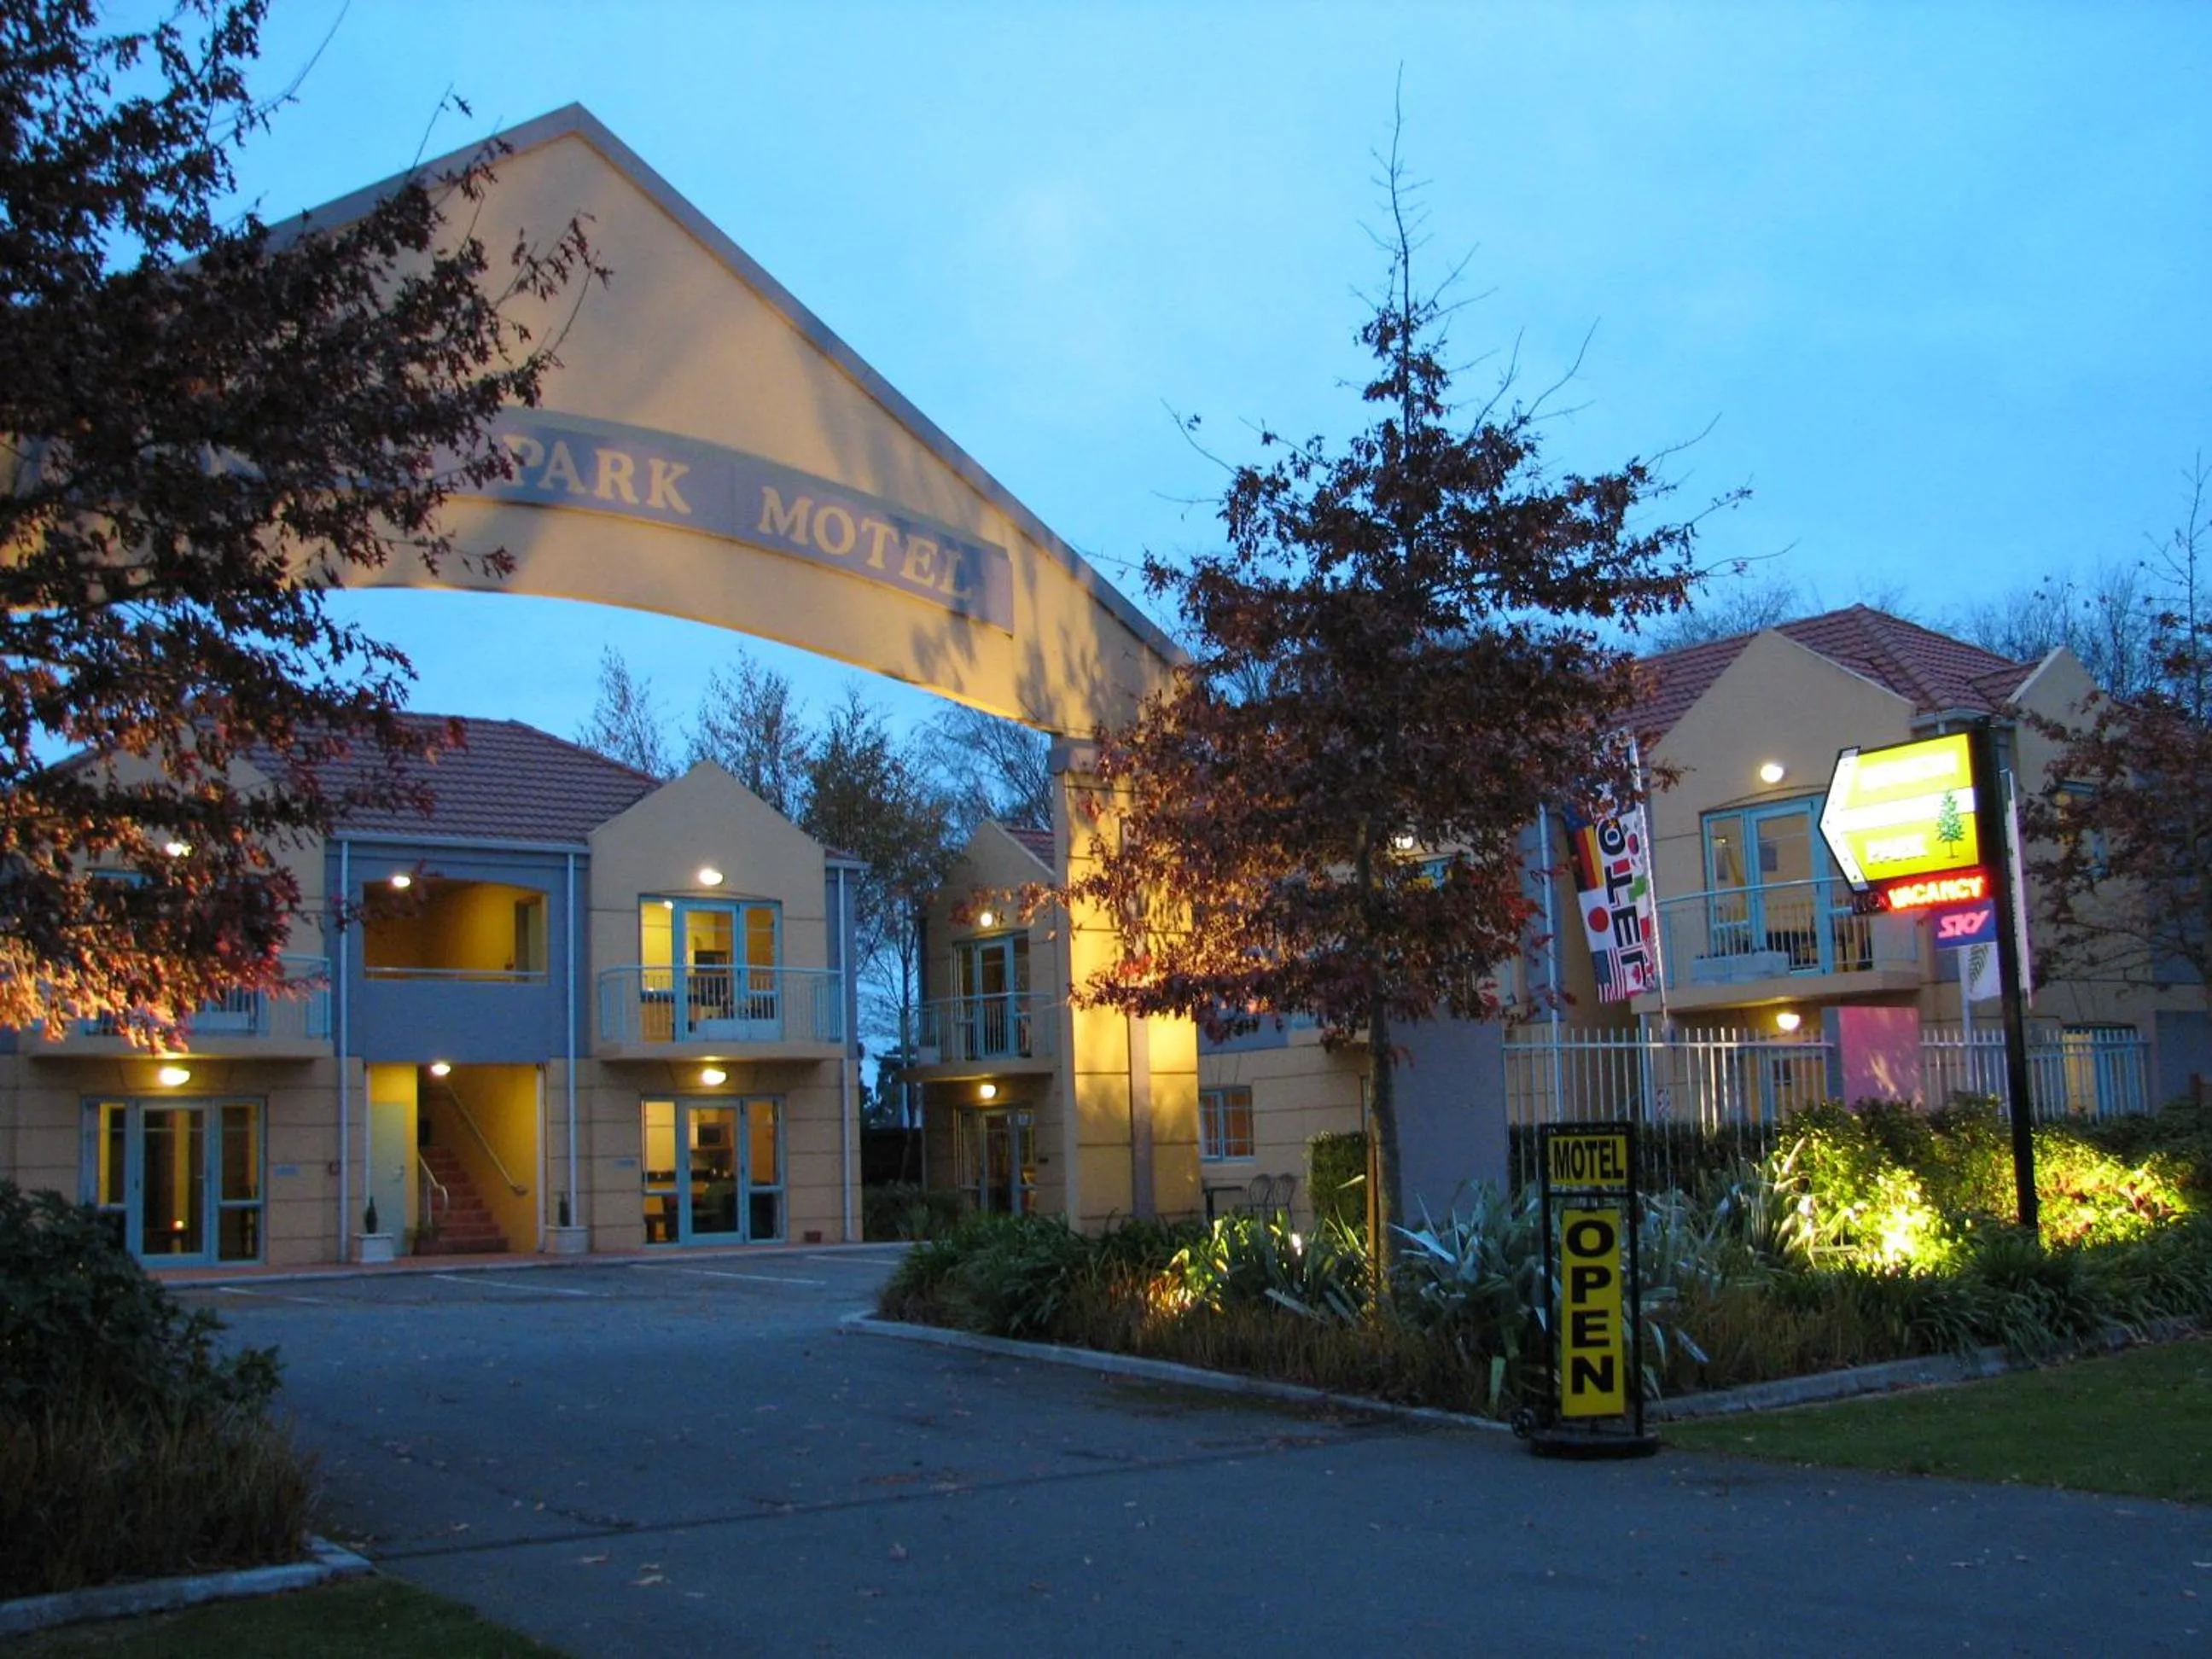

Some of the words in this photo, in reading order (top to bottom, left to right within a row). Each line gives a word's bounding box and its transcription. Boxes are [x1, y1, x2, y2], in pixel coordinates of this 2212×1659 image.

[503, 434, 692, 515] PARK
[758, 486, 973, 599] MOTEL
[1887, 875, 1985, 910] VACANCY
[1937, 909, 1991, 939] SKY
[1553, 1138, 1625, 1181] MOTEL
[1566, 1220, 1615, 1394] OPEN
